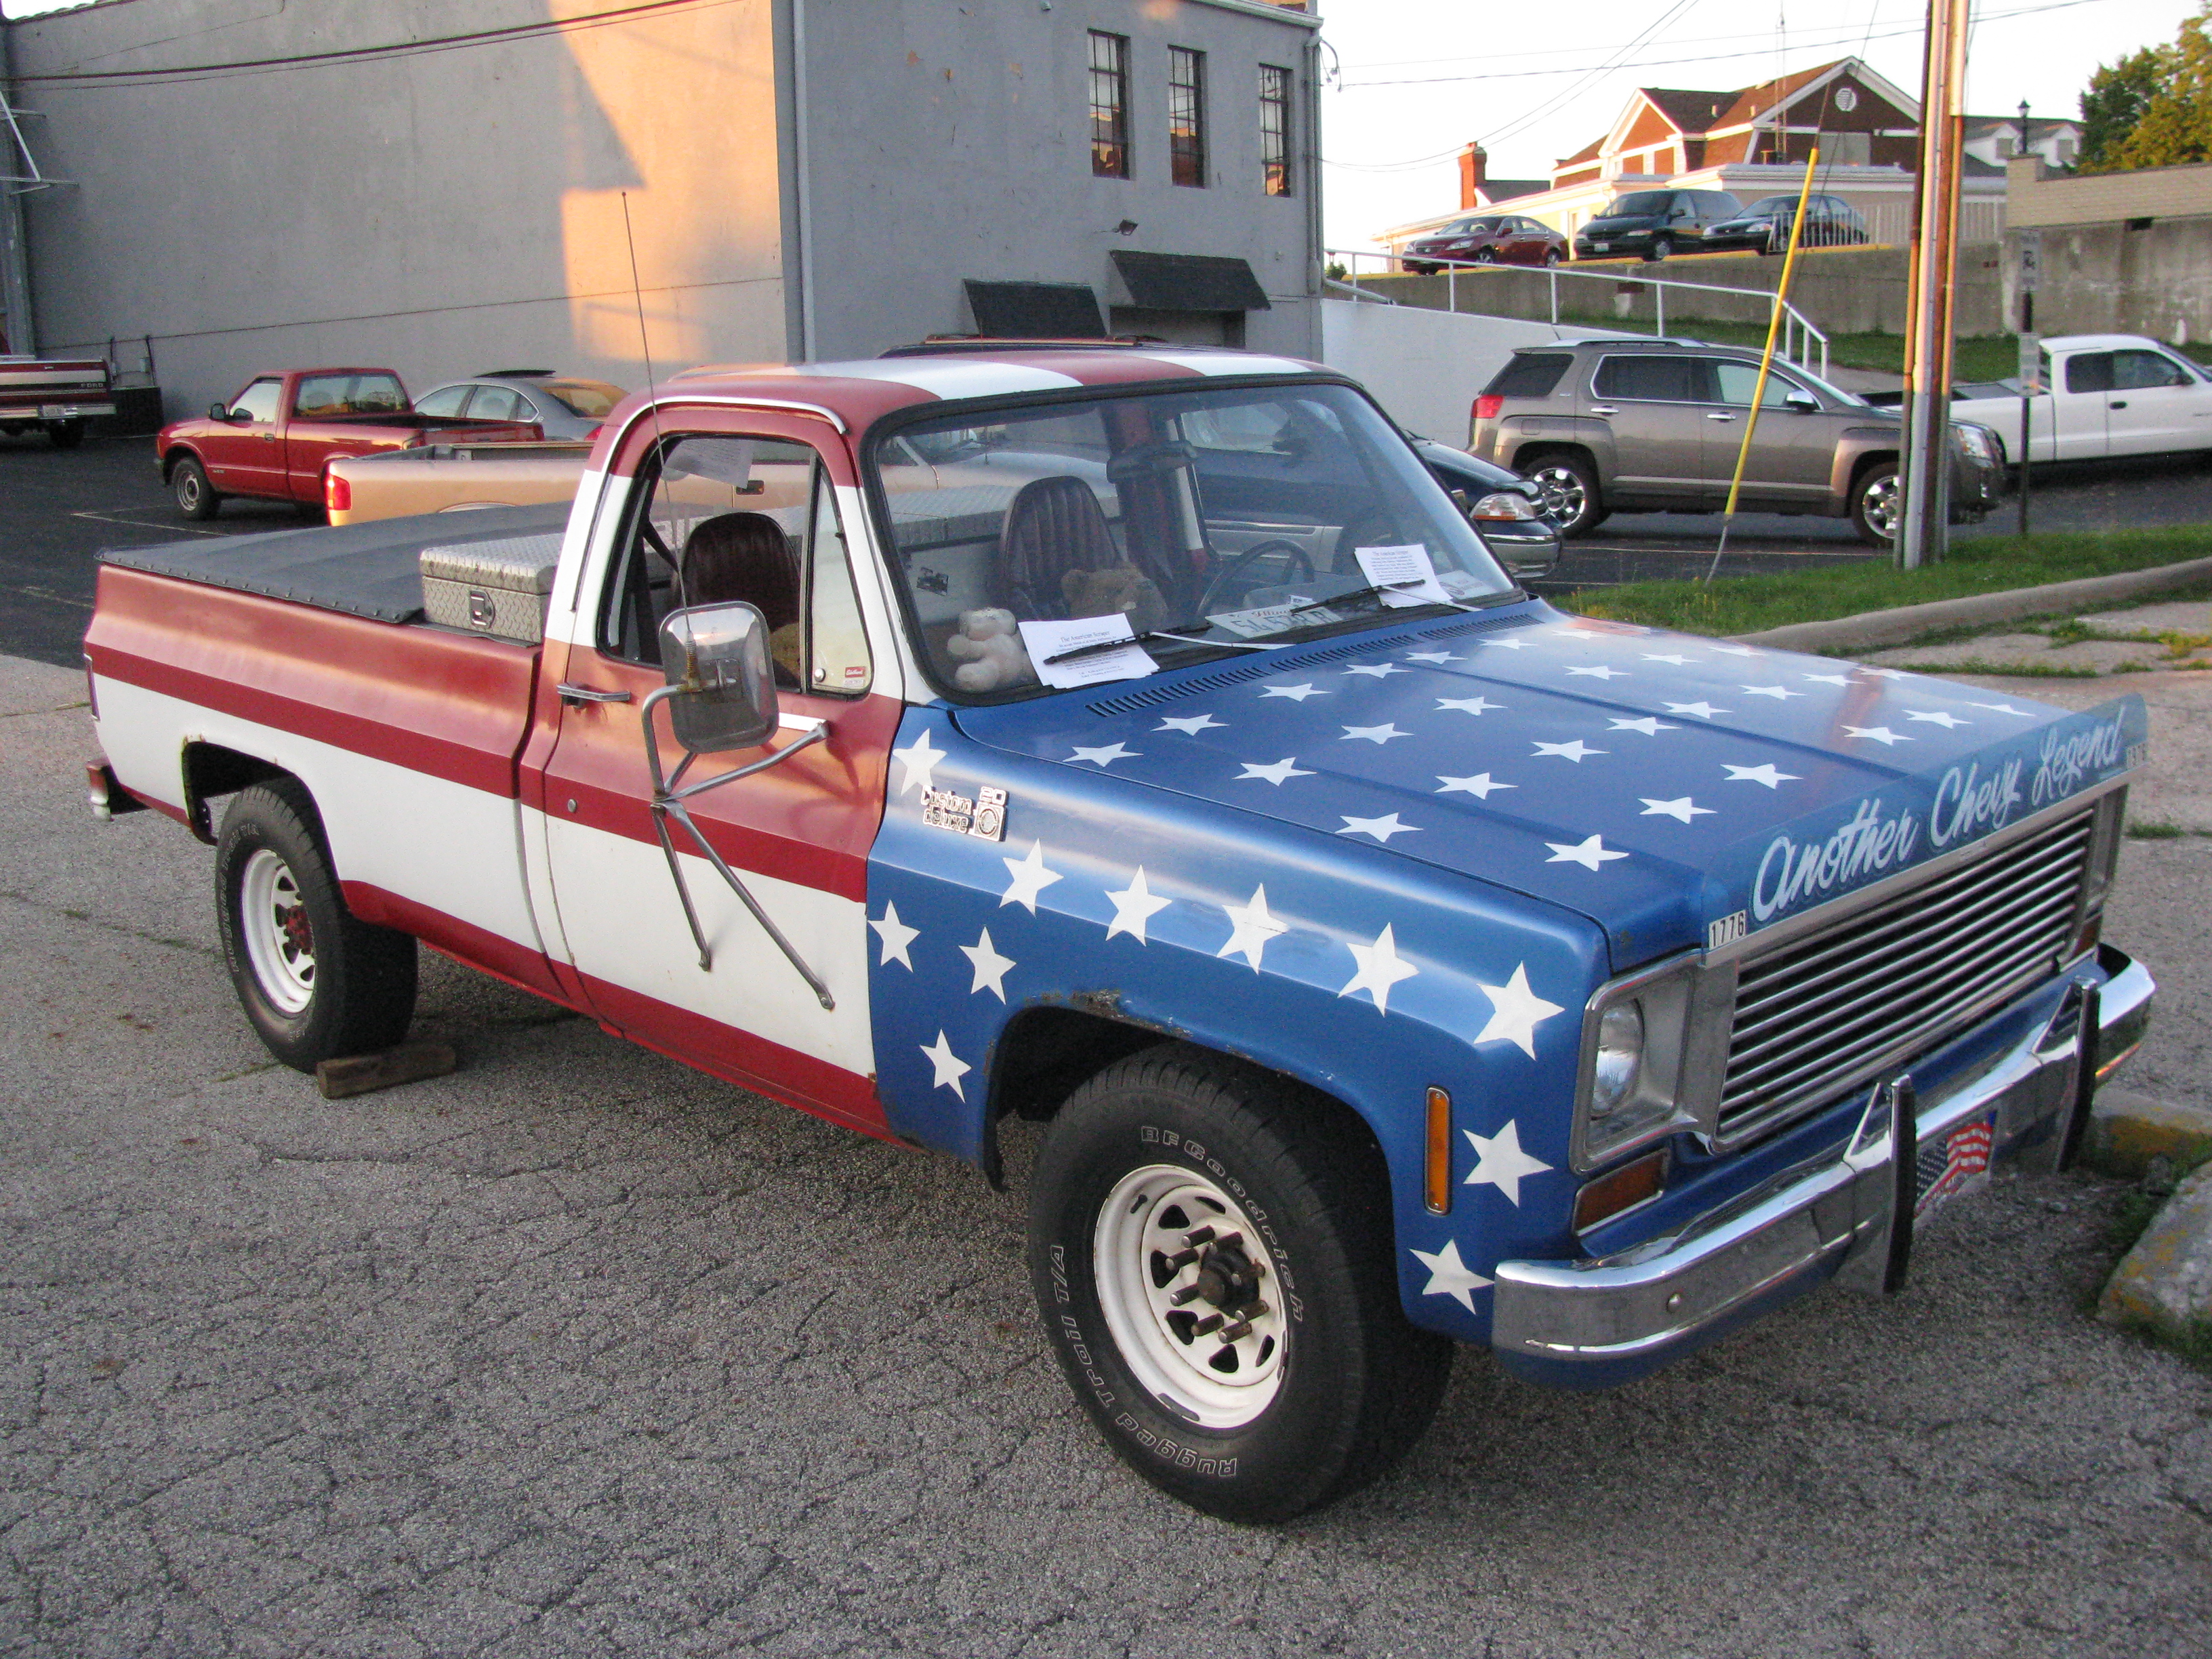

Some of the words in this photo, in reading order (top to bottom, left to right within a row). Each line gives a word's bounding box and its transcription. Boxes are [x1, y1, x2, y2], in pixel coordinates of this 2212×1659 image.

[1071, 633, 1092, 641] American
[920, 785, 972, 816] Custom
[1753, 798, 1919, 922] Another
[1931, 758, 2022, 848] Chevy
[2032, 703, 2127, 806] Legend
[1711, 912, 1744, 947] 1776
[1141, 1125, 1304, 1322] BFGoodrich
[1050, 1244, 1070, 1305] T/A
[1061, 1314, 1116, 1409] Trail
[1115, 1411, 1237, 1477] Rugged
